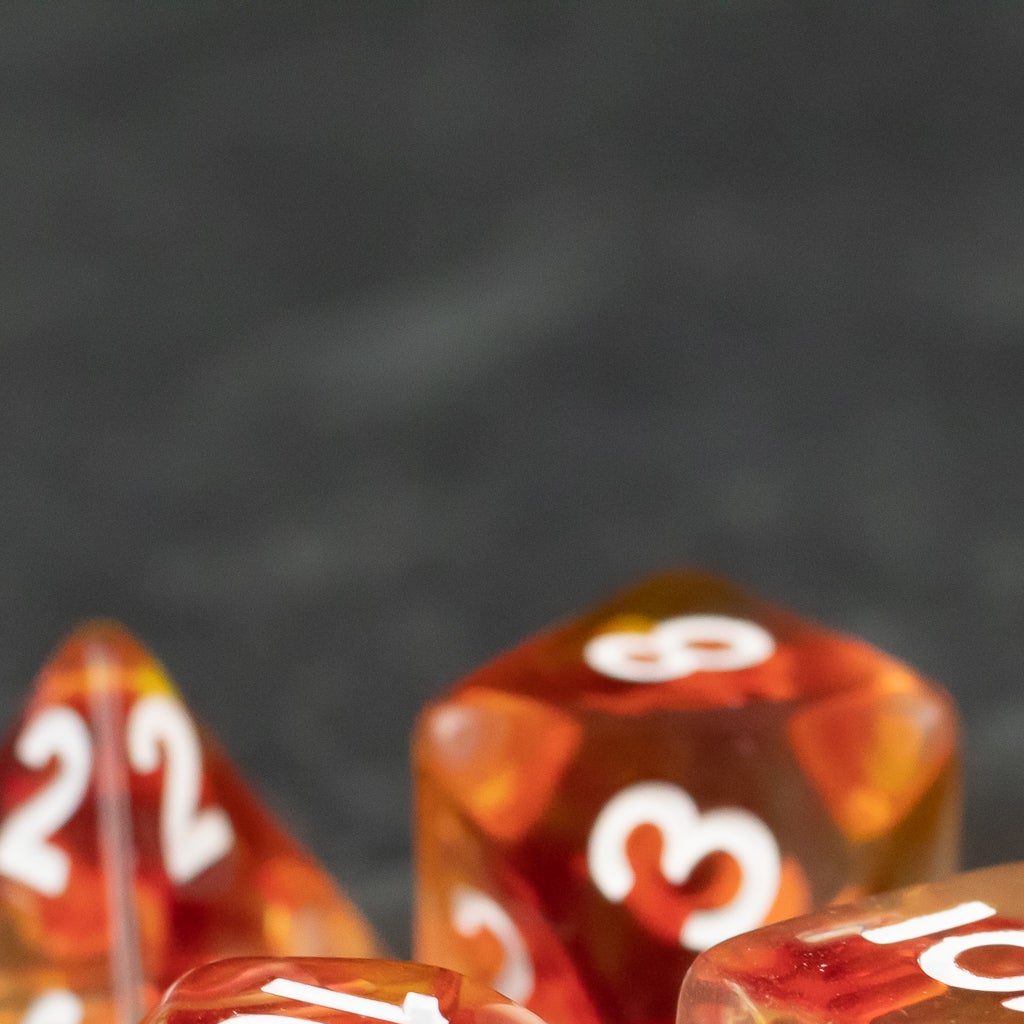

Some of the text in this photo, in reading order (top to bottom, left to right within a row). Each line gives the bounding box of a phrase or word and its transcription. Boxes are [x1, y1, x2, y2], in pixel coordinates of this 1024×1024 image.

[583, 613, 777, 684] 8
[0, 704, 93, 896] 2
[127, 693, 234, 882] 2
[588, 781, 782, 952] 3
